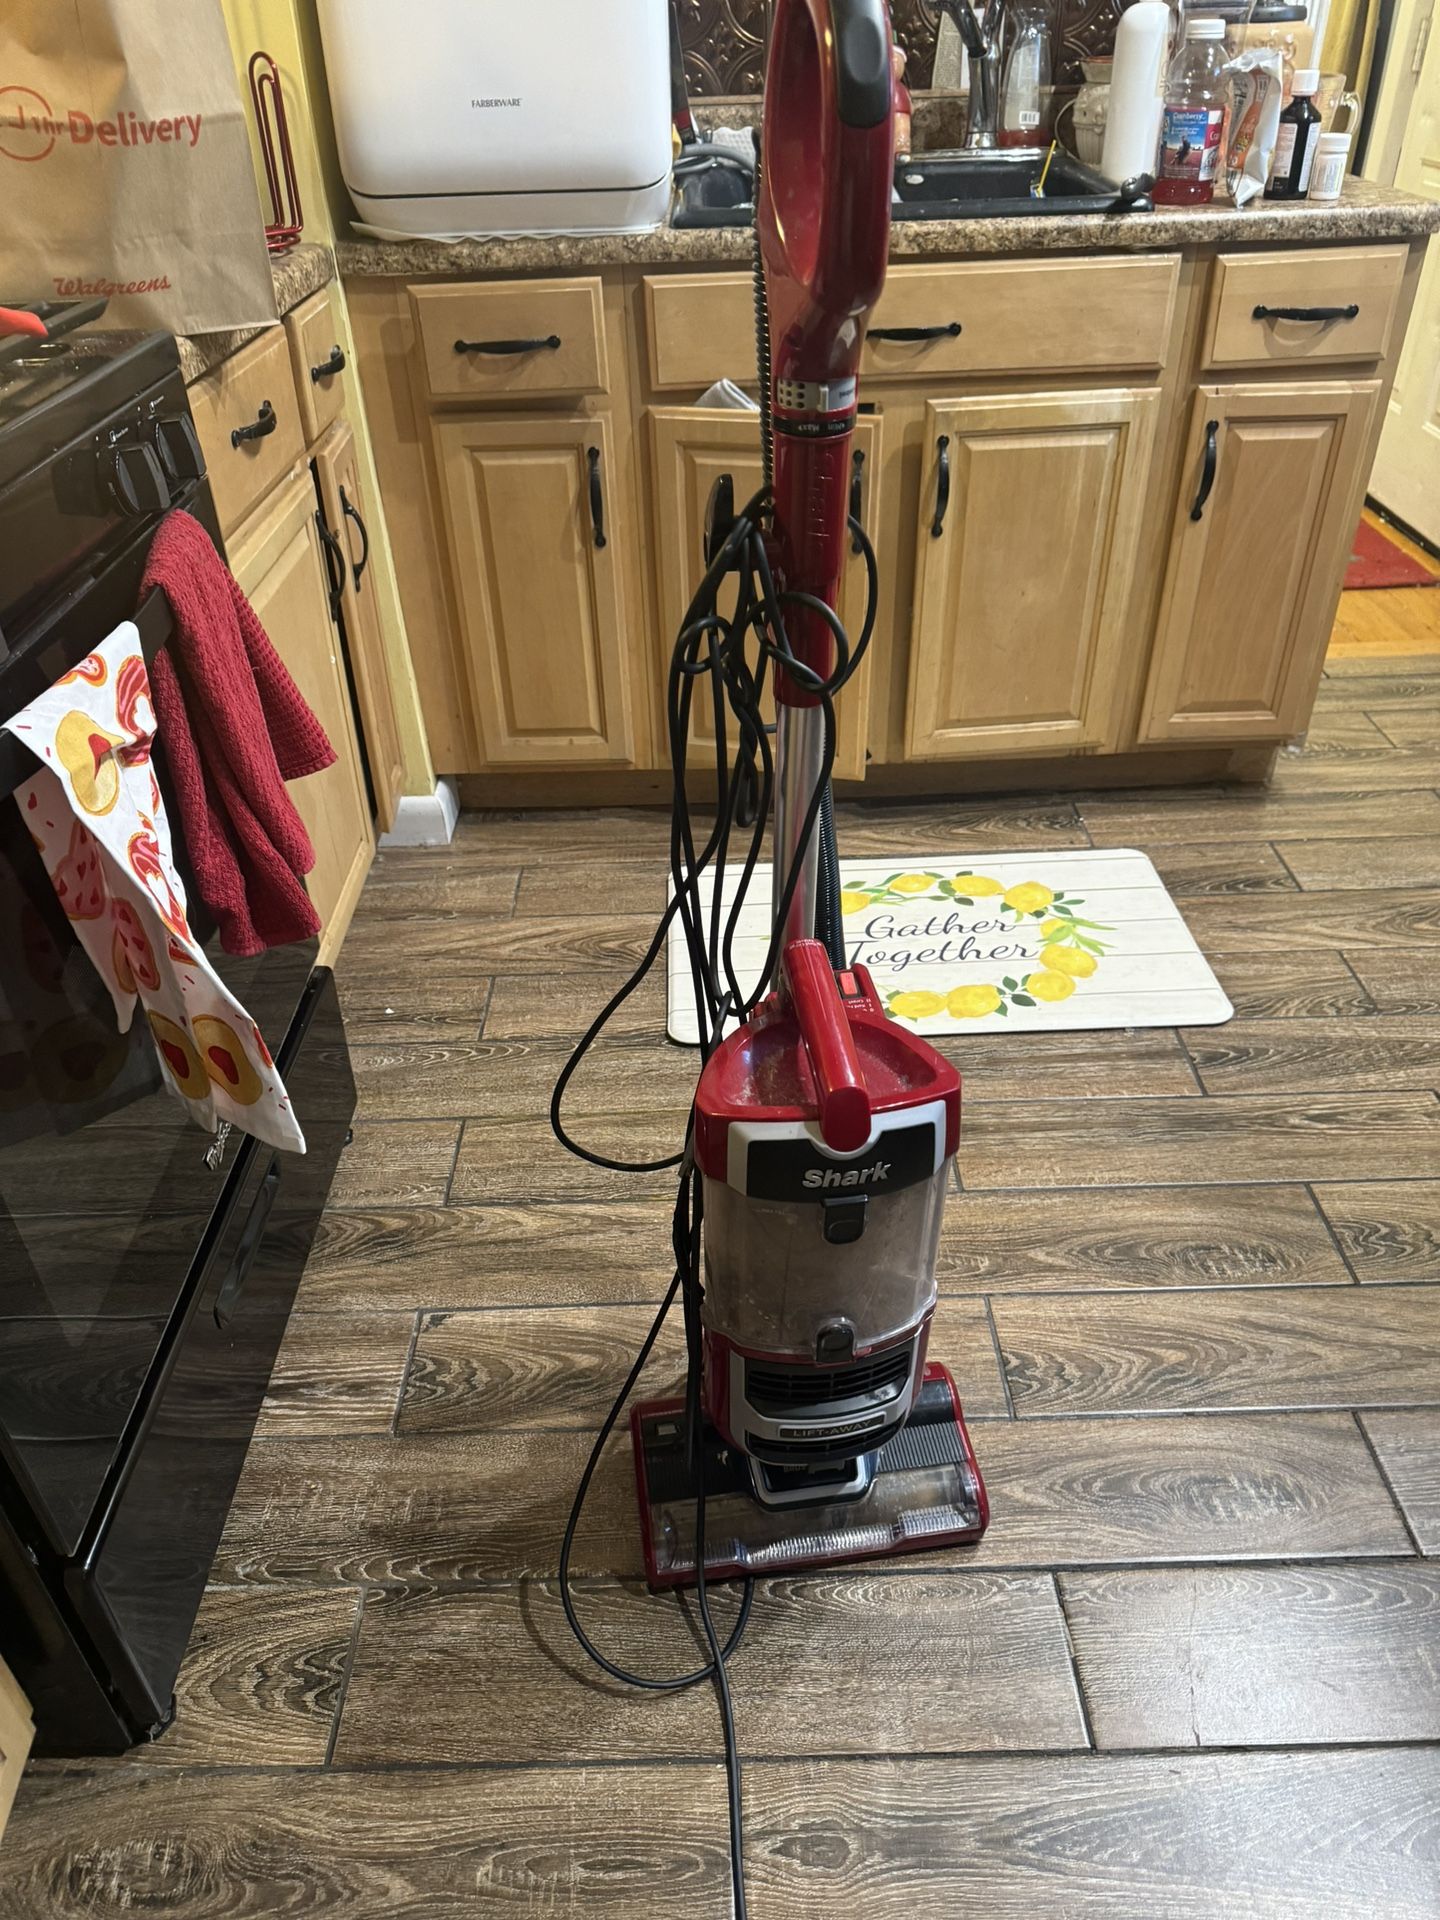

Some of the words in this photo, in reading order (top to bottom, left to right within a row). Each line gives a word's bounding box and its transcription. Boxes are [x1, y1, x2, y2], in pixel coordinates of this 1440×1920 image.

[471, 98, 520, 108] FARBERWARE
[68, 111, 202, 147] Delivery
[53, 275, 171, 298] Walgreens
[865, 912, 1016, 940] Gather
[845, 936, 1038, 972] Together
[802, 1161, 892, 1188] Shark
[793, 1420, 872, 1437] LIFT-AWAY
